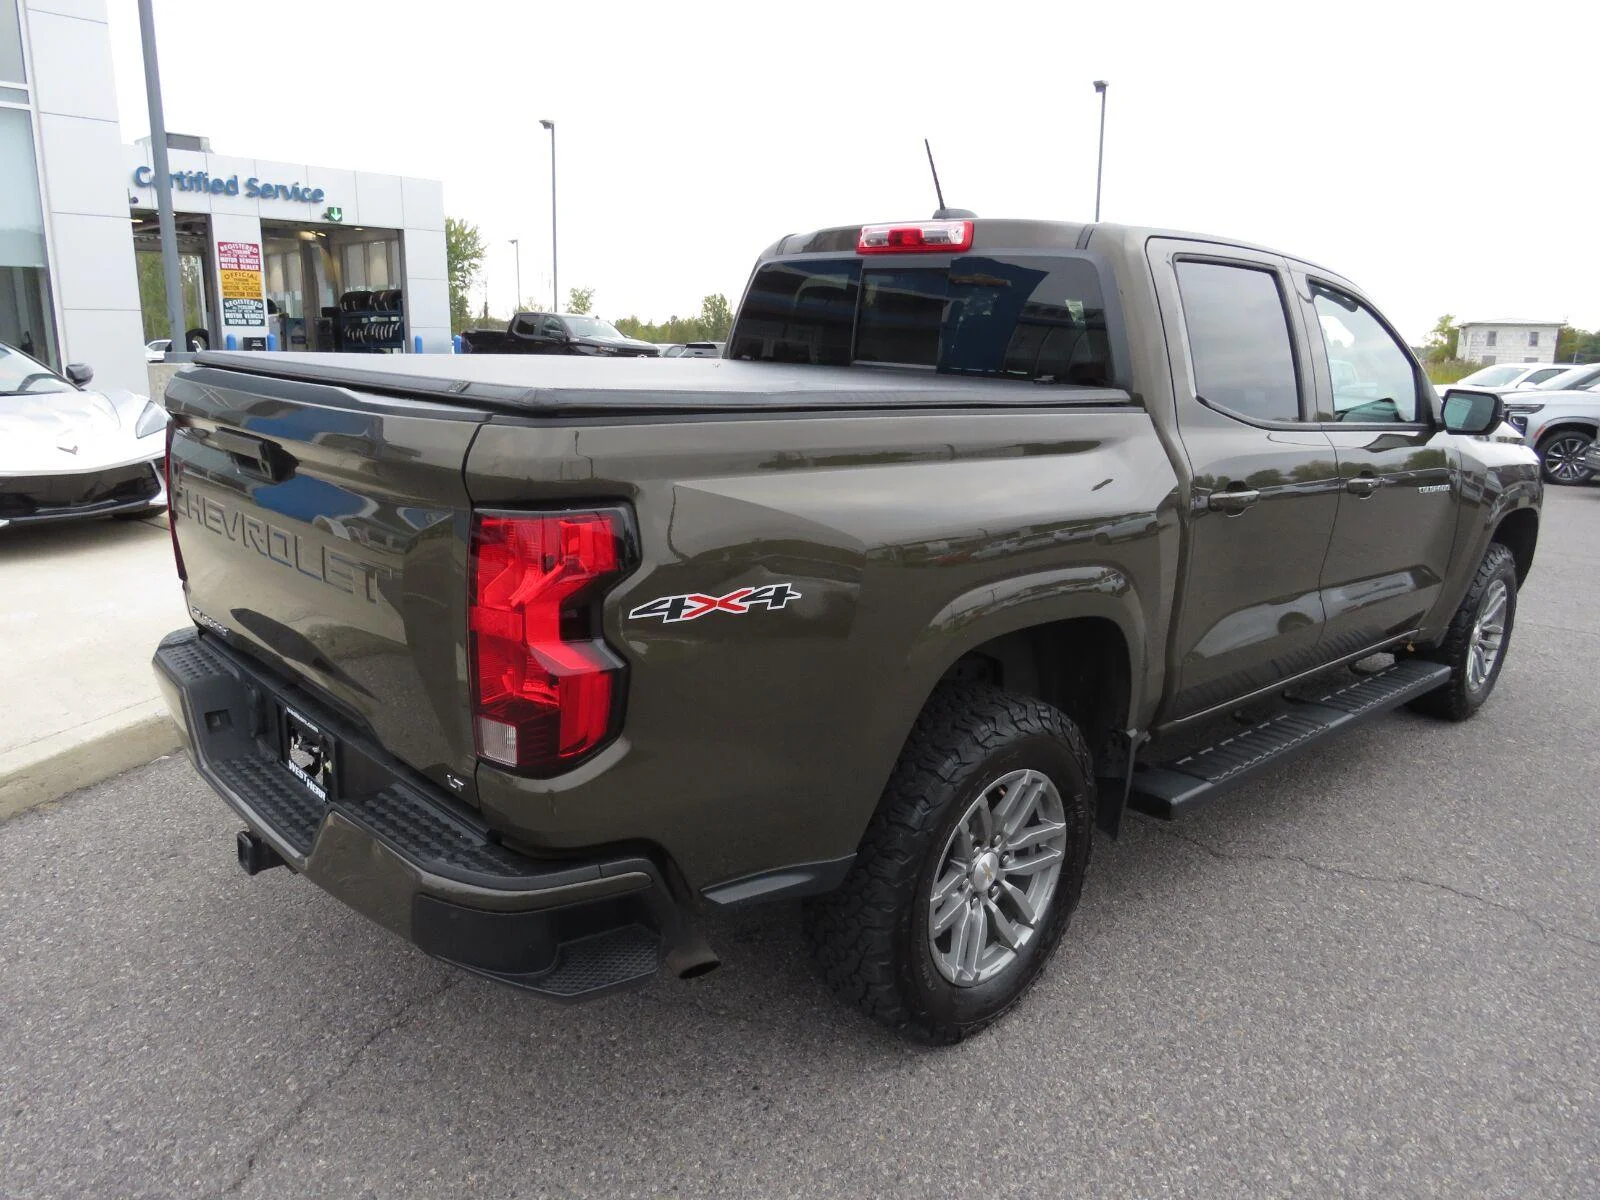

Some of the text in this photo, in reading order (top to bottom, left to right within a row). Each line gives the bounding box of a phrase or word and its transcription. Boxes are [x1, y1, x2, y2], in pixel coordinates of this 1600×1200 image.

[134, 166, 324, 203] Crtified Service
[219, 243, 258, 254] REGISTERED
[224, 272, 258, 282] OFFICIAL
[225, 299, 263, 309] REGISTERED
[288, 759, 326, 802] WEST HERR
